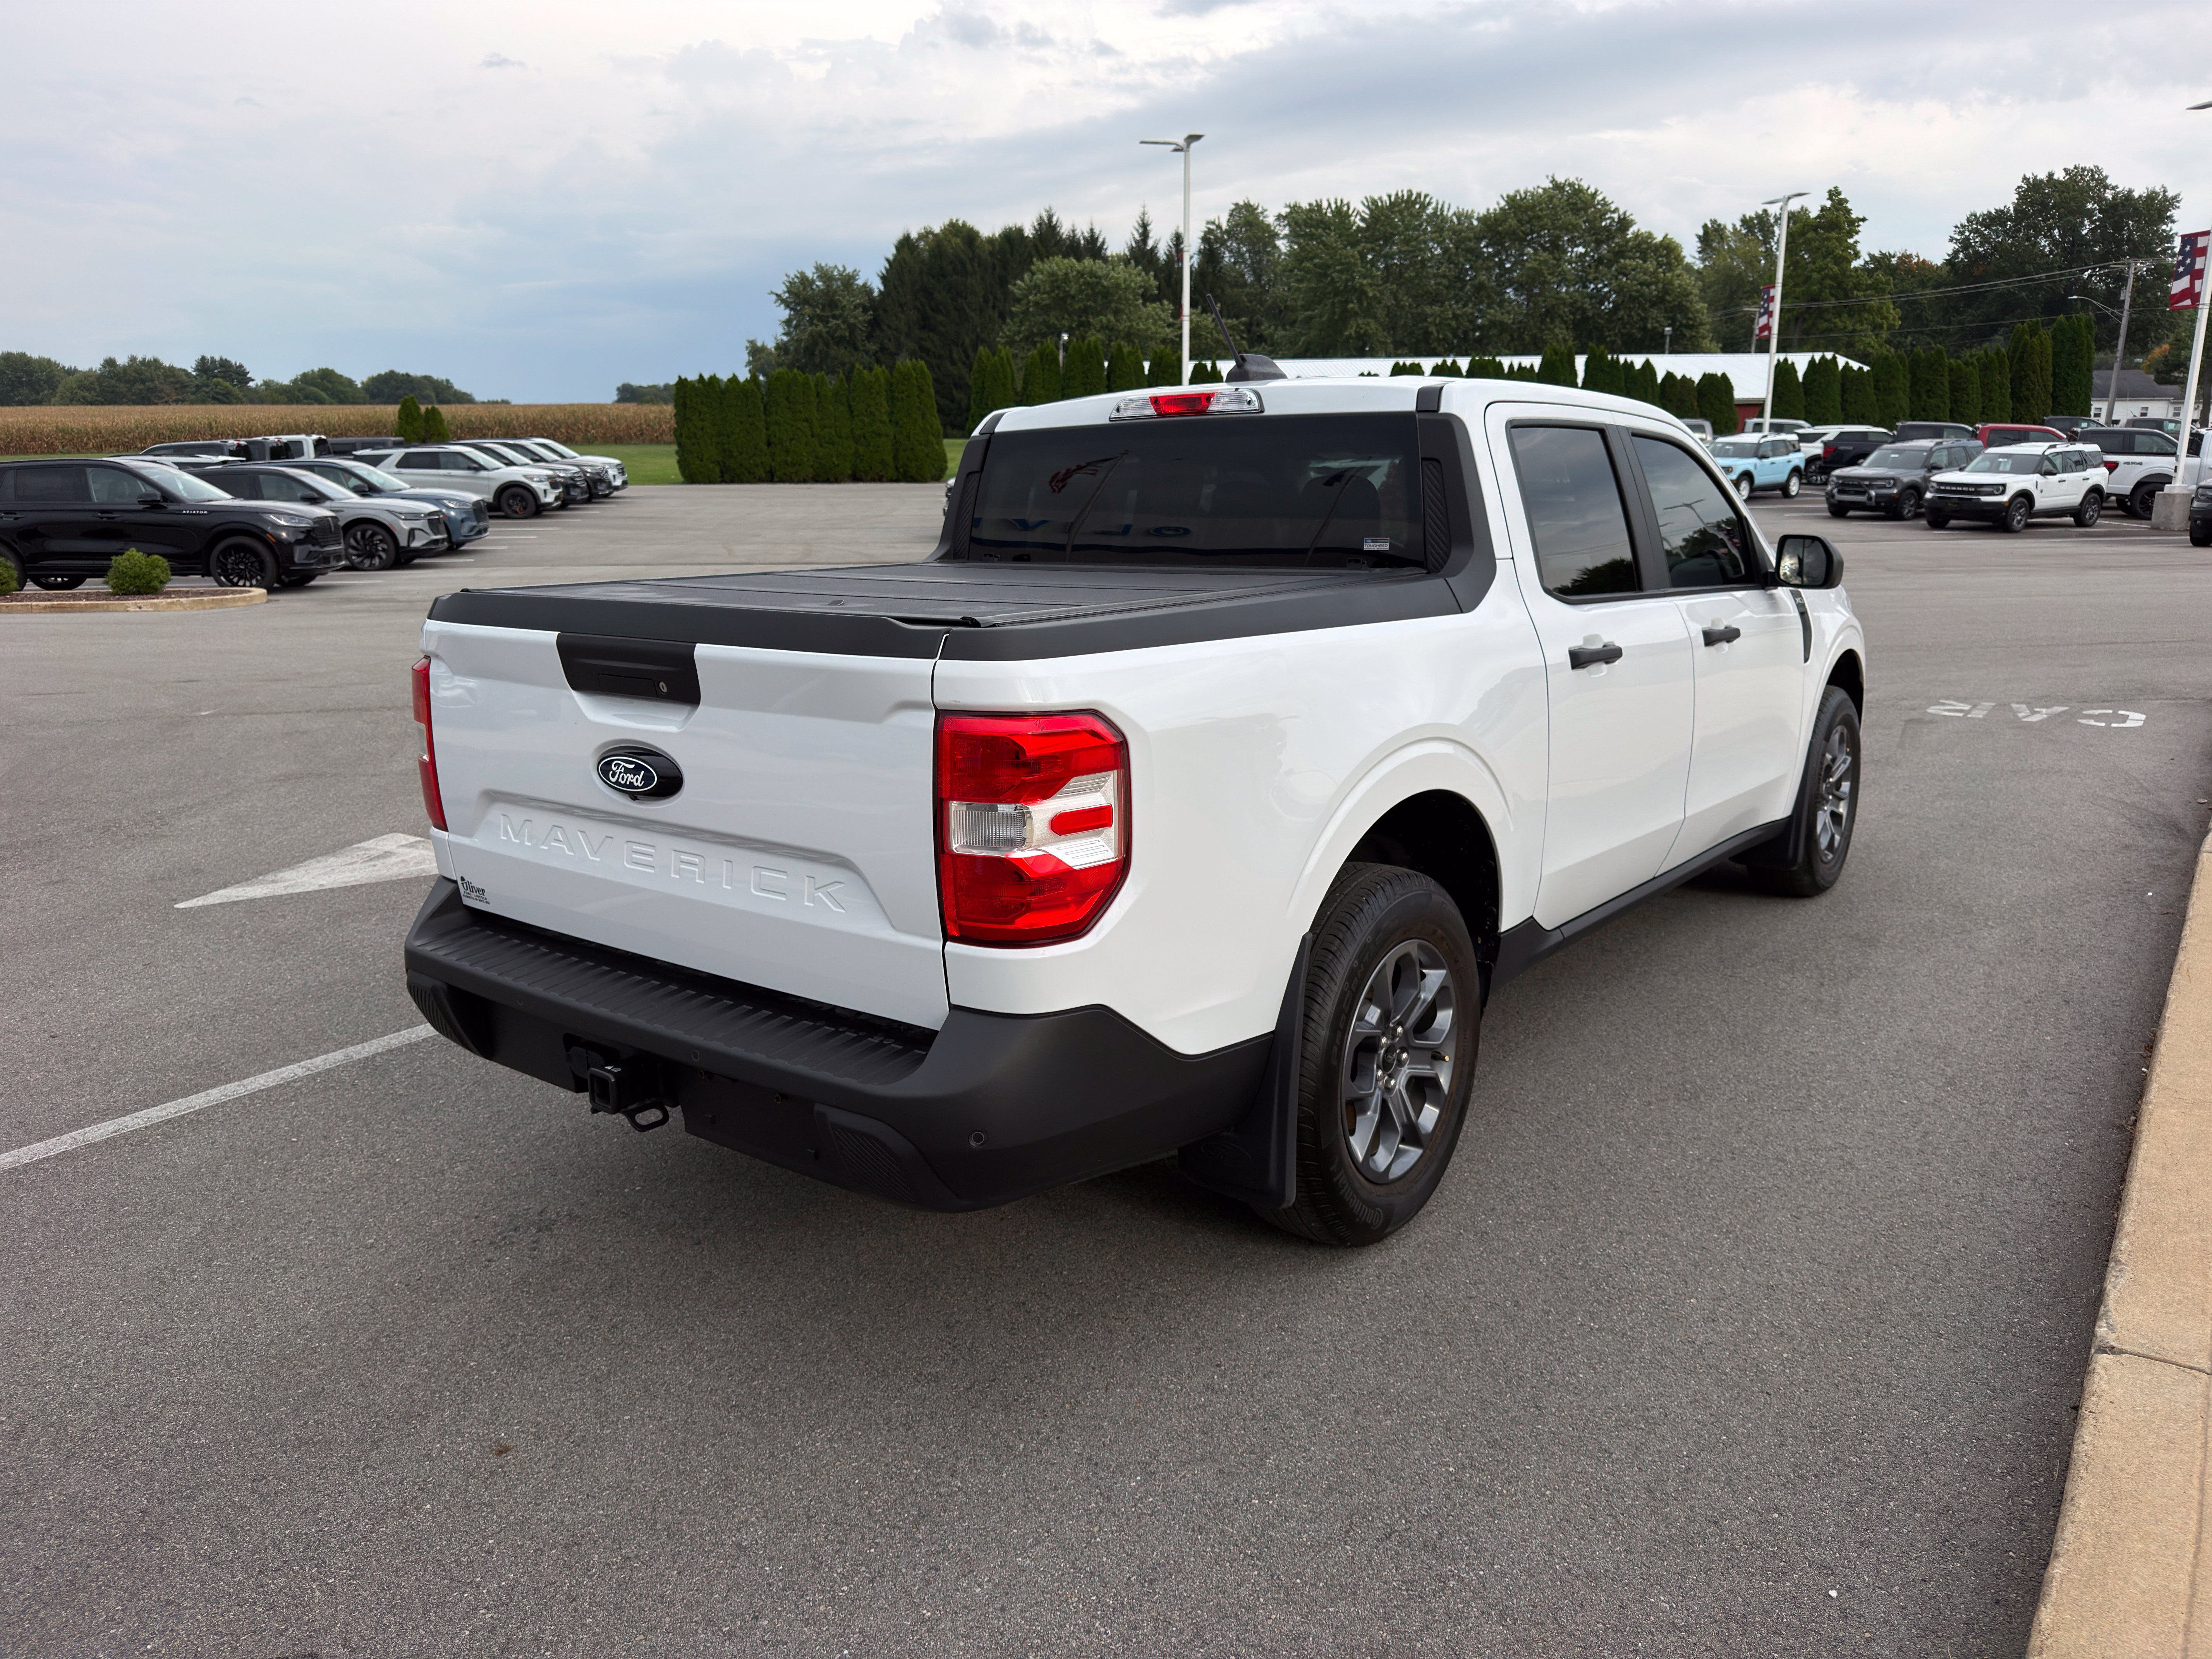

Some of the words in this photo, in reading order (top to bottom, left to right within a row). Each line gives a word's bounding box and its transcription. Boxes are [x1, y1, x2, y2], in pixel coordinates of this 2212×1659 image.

[1926, 699, 2147, 728] CAR
[609, 760, 645, 787] Ford
[499, 813, 846, 914] MAVERICK
[460, 876, 486, 896] Oliver
[1333, 1169, 1384, 1230] Continental
